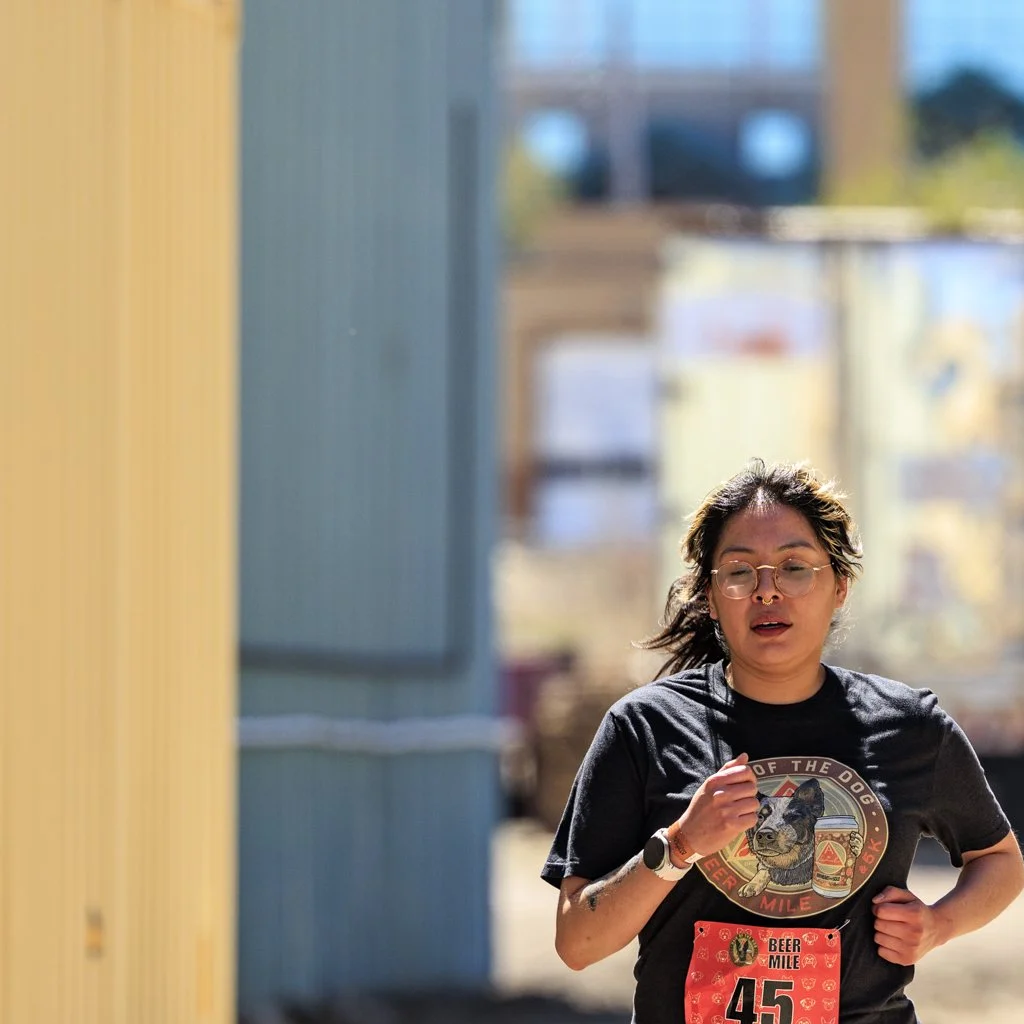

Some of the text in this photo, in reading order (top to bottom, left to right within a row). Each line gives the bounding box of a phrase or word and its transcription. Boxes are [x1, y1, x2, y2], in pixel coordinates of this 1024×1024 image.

[755, 760, 875, 805] OF THE DOG
[703, 858, 738, 891] EER
[760, 895, 813, 913] MILE
[768, 938, 801, 953] BEER
[768, 954, 800, 969] MILE
